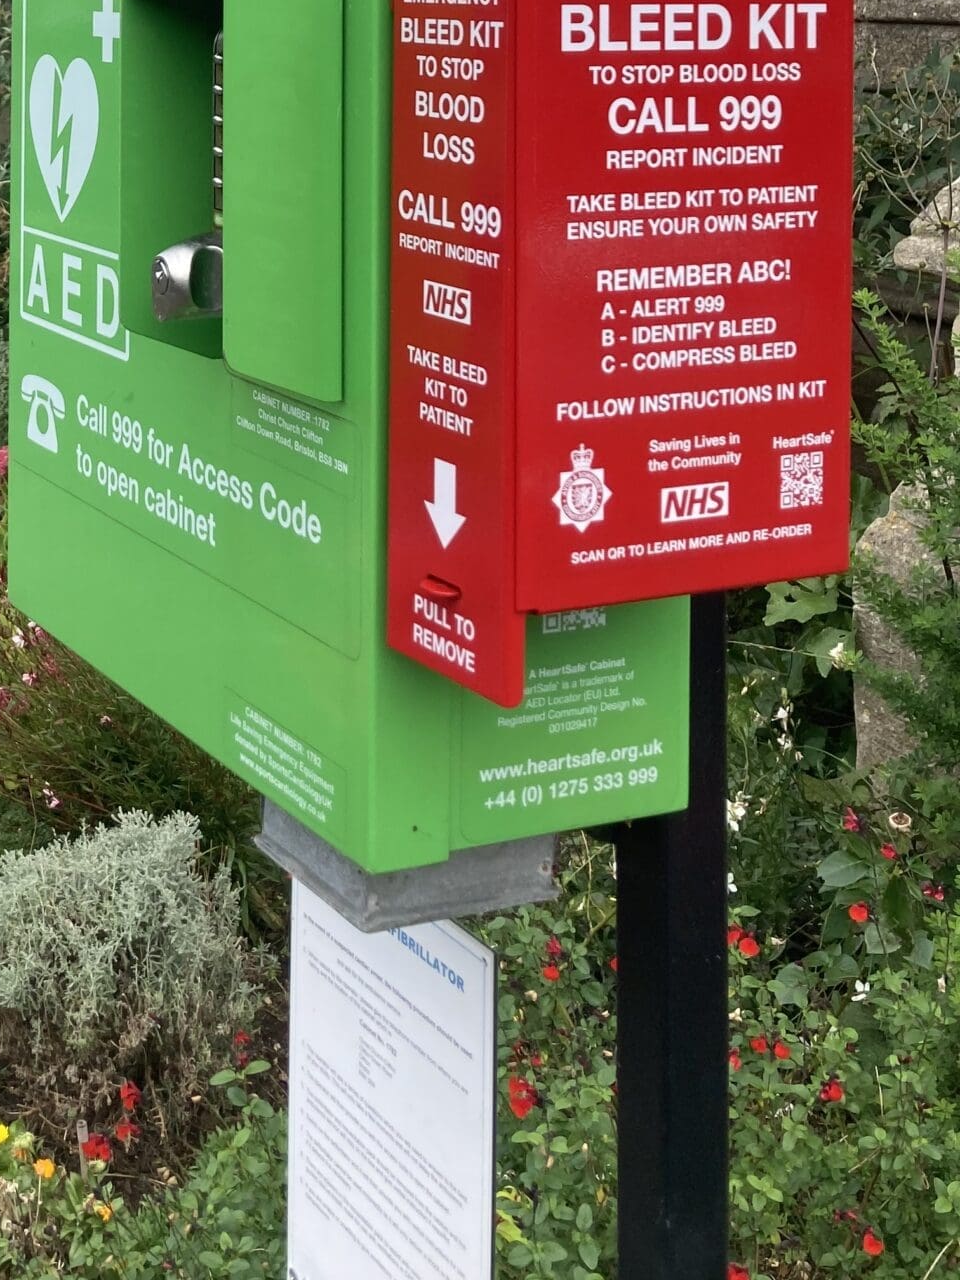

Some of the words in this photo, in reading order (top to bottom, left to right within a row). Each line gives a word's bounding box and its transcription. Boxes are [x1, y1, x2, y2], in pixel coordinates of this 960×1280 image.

[401, 17, 464, 46] BLEED
[470, 21, 504, 48] KIT
[560, 4, 732, 52] BLEED
[748, 3, 827, 50] KIT
[416, 55, 437, 77] TO
[441, 57, 484, 80] STOP
[589, 66, 616, 85] TO
[621, 65, 674, 84] STOP
[679, 64, 747, 83] BLOOD
[752, 62, 801, 81] LOSS
[415, 90, 485, 123] BLOOD
[608, 96, 709, 135] CALL
[719, 95, 782, 131] 999
[423, 132, 475, 165] LOSS
[606, 148, 687, 170] REPORT
[693, 145, 783, 167] INCIDENT
[398, 189, 455, 229] CALL
[461, 201, 501, 238] 999
[567, 194, 615, 213] TAKE
[620, 192, 681, 210] BLEED
[686, 190, 715, 208] KIT
[719, 189, 741, 206] TO
[748, 185, 817, 205] PATIENT
[567, 218, 644, 240] ENSURE
[648, 216, 700, 236] YOUR
[704, 214, 747, 233] OWN
[752, 211, 817, 231] SAFETY
[399, 233, 441, 255] REPORT
[445, 243, 500, 269] INCIDENT
[27, 244, 119, 338] AED
[596, 262, 731, 292] REMEMBER
[737, 259, 791, 283] ABC!
[425, 284, 468, 320] NHS
[630, 297, 690, 318] ALERT
[694, 295, 725, 313] 999
[632, 322, 714, 345] IDENTIFY
[719, 317, 777, 338] BLEED
[407, 345, 440, 371] TAKE
[443, 356, 487, 385] BLEED
[632, 346, 735, 371] COMPRESS
[740, 341, 797, 362] BLEED
[252, 390, 280, 409] CABINET
[425, 377, 446, 400] KIT
[449, 384, 468, 407] TO
[556, 398, 635, 421] FOLLOW
[640, 385, 772, 414] INSTRUCTIONS
[777, 384, 796, 401] IN
[799, 381, 826, 399] KIT
[258, 408, 277, 424] Christ
[278, 417, 300, 434] Church
[302, 427, 324, 445] Clifton
[419, 402, 473, 436] PATIENT
[649, 437, 690, 453] Saving
[694, 435, 726, 449] Lives
[76, 394, 107, 437] Call
[112, 411, 143, 454] 999
[147, 428, 173, 468] for
[178, 443, 253, 510] Access
[259, 482, 321, 545] Code
[648, 459, 669, 472] the
[671, 452, 741, 470] Community
[76, 444, 92, 478] to
[97, 461, 139, 505] open
[145, 486, 216, 547] cabinet
[664, 486, 725, 519] NHS
[571, 548, 605, 565] SCAN
[647, 539, 686, 555] LEARN
[689, 534, 723, 550] MORE
[726, 531, 750, 546] AND
[753, 524, 812, 542] RE-ORDER
[414, 593, 451, 631] PULL
[454, 613, 475, 641] TO
[413, 622, 475, 673] REMOVE
[590, 657, 625, 670] Cabinet
[580, 672, 623, 687] trademark
[498, 712, 545, 728] Registered
[548, 705, 597, 719] Community
[601, 701, 630, 712] Design
[548, 694, 581, 705] Locator
[479, 738, 663, 783] www.heartsafe.org.uk
[484, 790, 516, 810] +44
[522, 785, 543, 807] (0)
[549, 778, 588, 800] 1275
[593, 773, 623, 792] 333
[628, 766, 658, 787] 999
[388, 928, 465, 993] FIBRILLATOR
